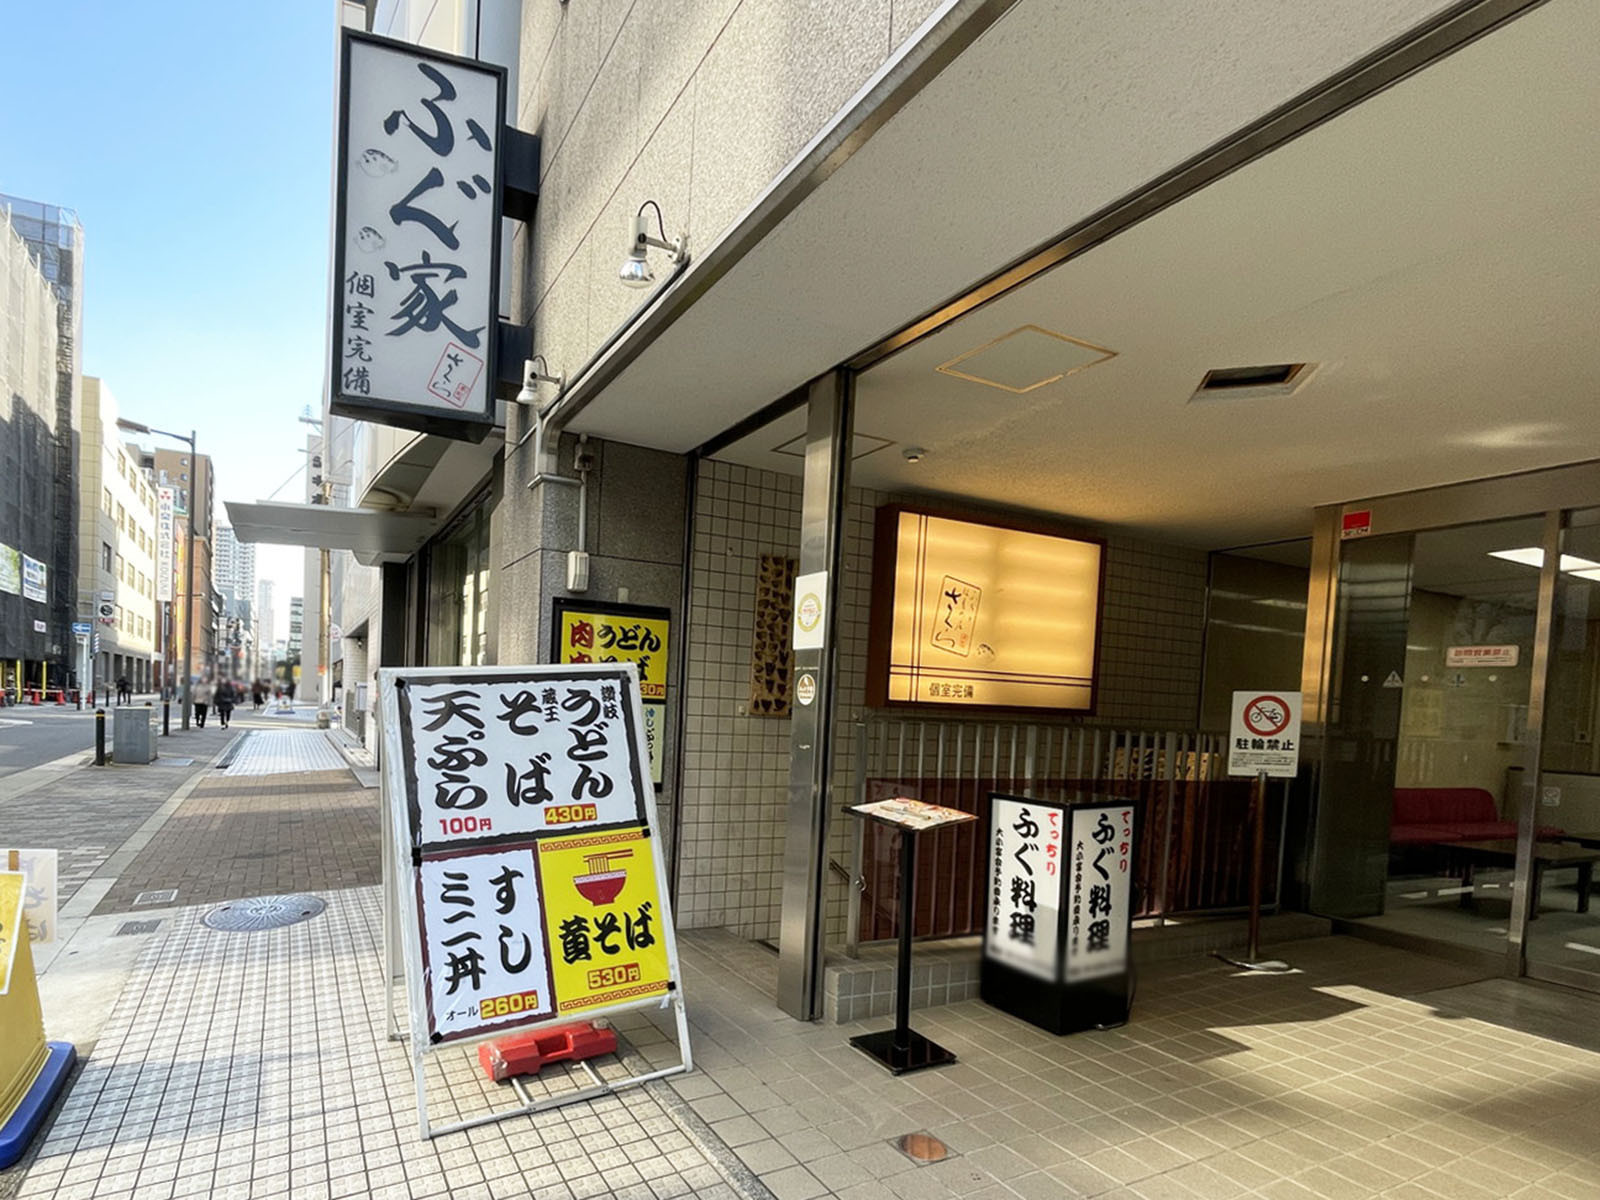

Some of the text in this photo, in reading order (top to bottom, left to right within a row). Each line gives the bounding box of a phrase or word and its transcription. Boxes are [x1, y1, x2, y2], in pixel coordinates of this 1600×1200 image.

[383, 62, 493, 348] ふぐ家
[341, 269, 375, 395] 個室完備
[570, 619, 662, 653] 肉うどん
[541, 686, 561, 723] 蔵王
[640, 682, 665, 697] 30円
[421, 689, 489, 810] 天ぷら
[496, 689, 554, 807] そば
[561, 687, 614, 801] うどん
[1235, 737, 1295, 751] 駐輪禁止
[439, 816, 492, 834] 100円
[545, 804, 597, 823] 430円
[1046, 812, 1060, 876] てっちり
[1119, 811, 1131, 873] てっちり
[1008, 807, 1040, 947] ふぐ料理
[1086, 812, 1116, 954] ふぐ料理
[440, 870, 487, 996] ミニ丼
[488, 865, 533, 975] すし
[558, 900, 656, 965] 黄そば
[446, 992, 539, 1022] オール 260円
[588, 964, 641, 989] 530円
